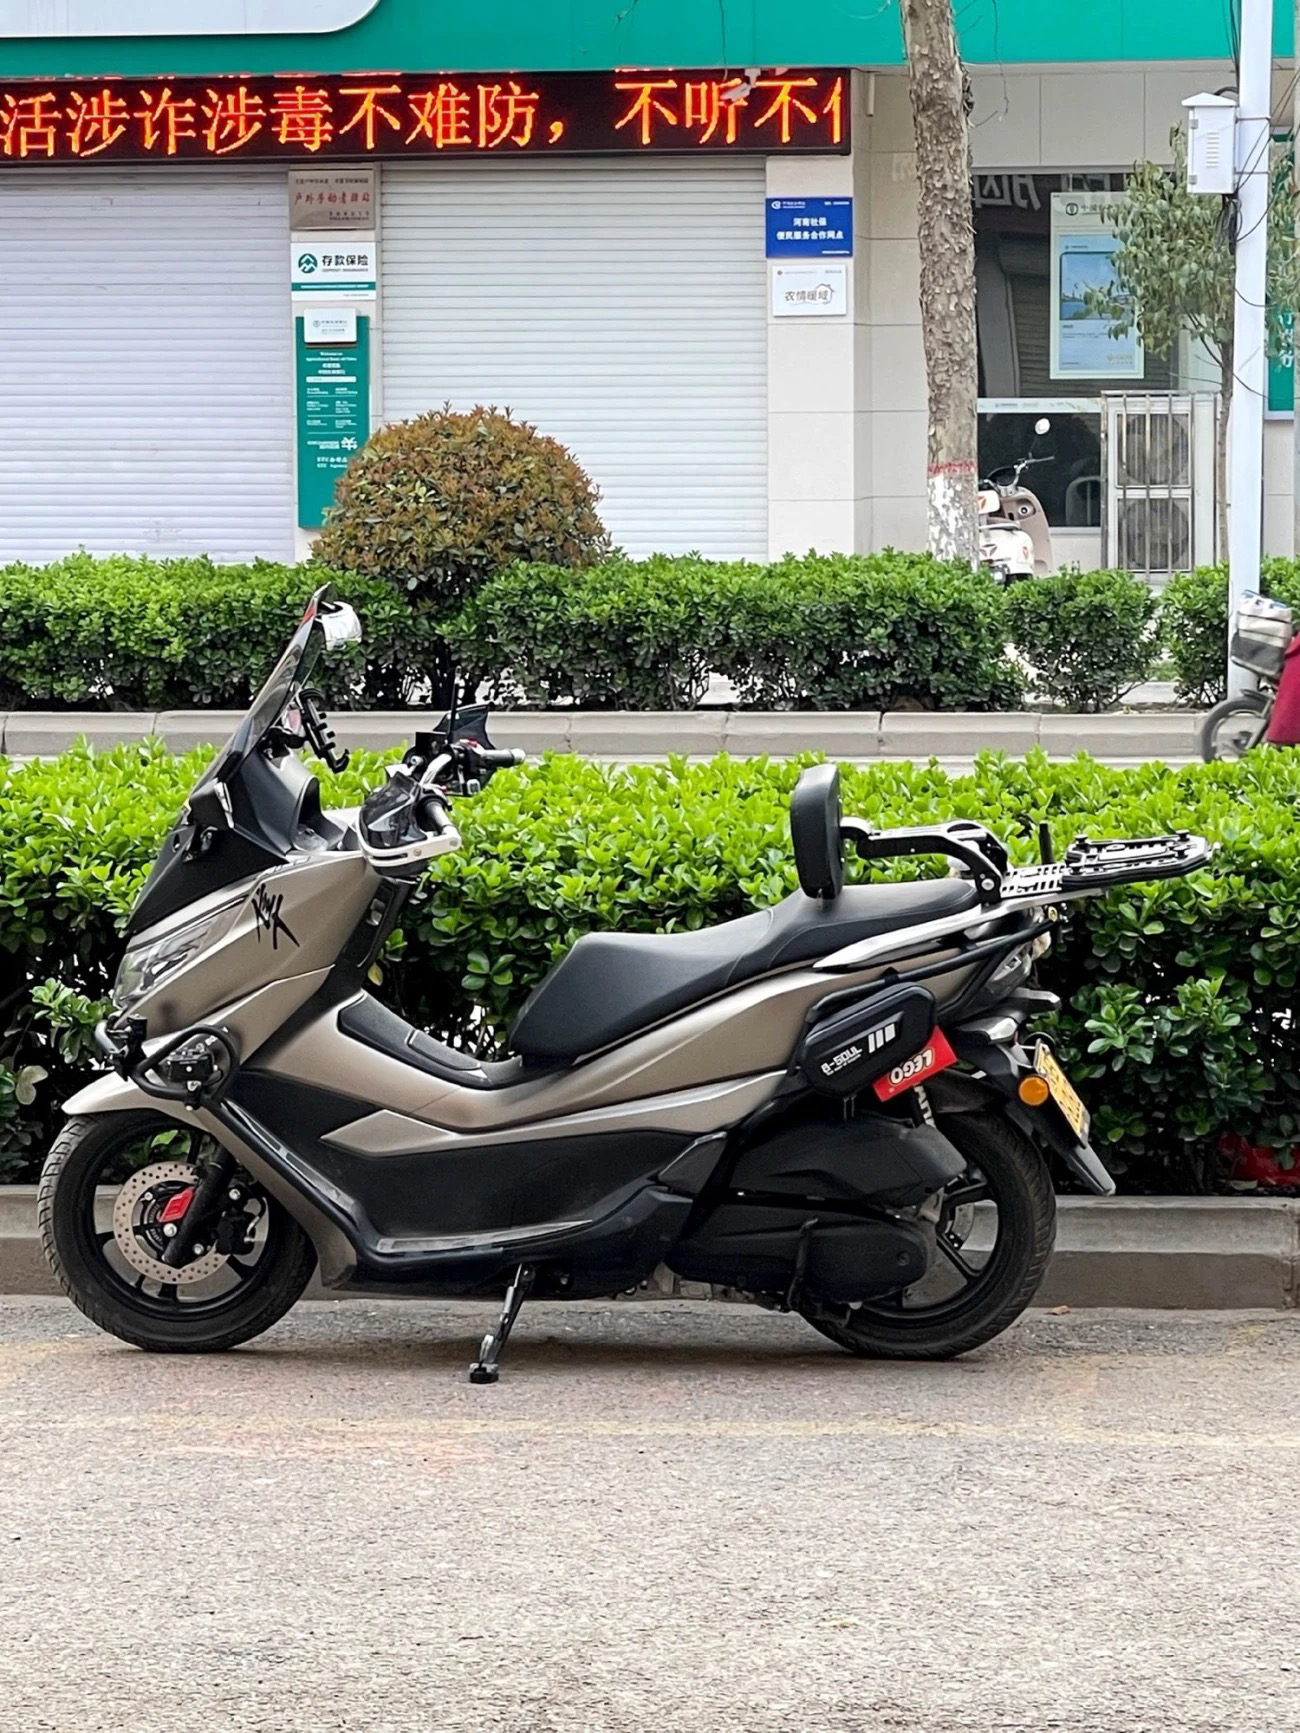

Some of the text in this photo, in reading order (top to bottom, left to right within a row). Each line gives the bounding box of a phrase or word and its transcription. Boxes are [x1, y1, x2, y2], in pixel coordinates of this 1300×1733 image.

[321, 254, 369, 266] 存款保险
[889, 1049, 934, 1085] LEGO
